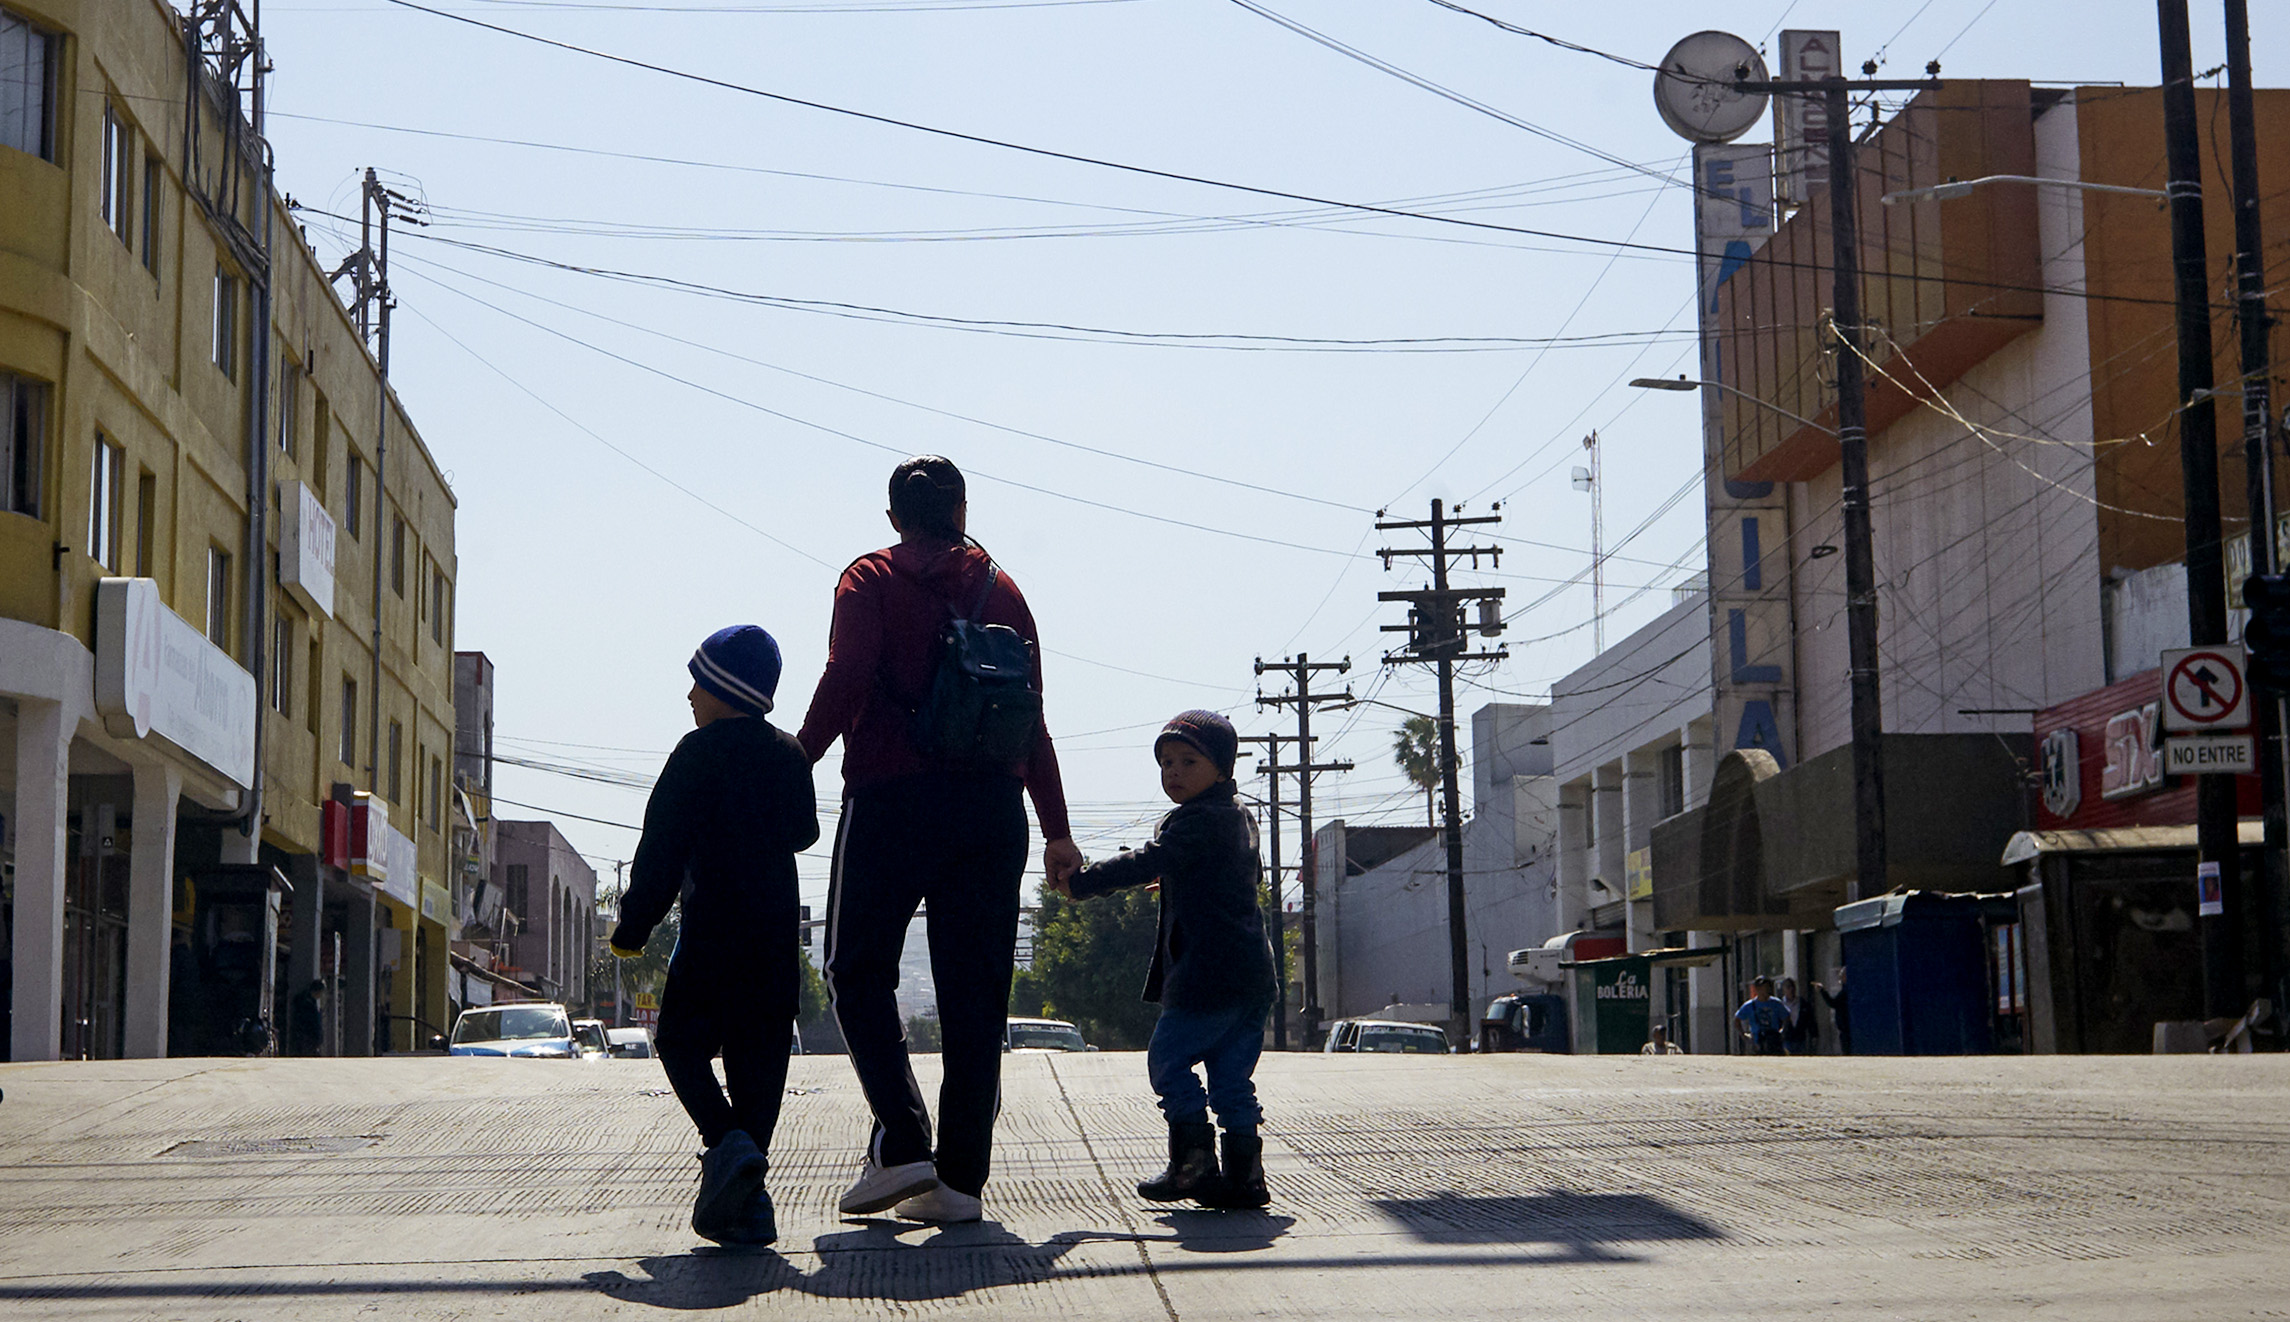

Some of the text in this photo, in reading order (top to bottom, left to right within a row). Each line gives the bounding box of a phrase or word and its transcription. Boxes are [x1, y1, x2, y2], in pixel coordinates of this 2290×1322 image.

[1706, 160, 1769, 228] EL
[308, 496, 334, 578] HOTEL
[2102, 699, 2165, 800] SIX
[2173, 744, 2247, 764] NO ENTRE
[1597, 985, 1649, 999] BOLERIA
[1615, 970, 1636, 986] La
